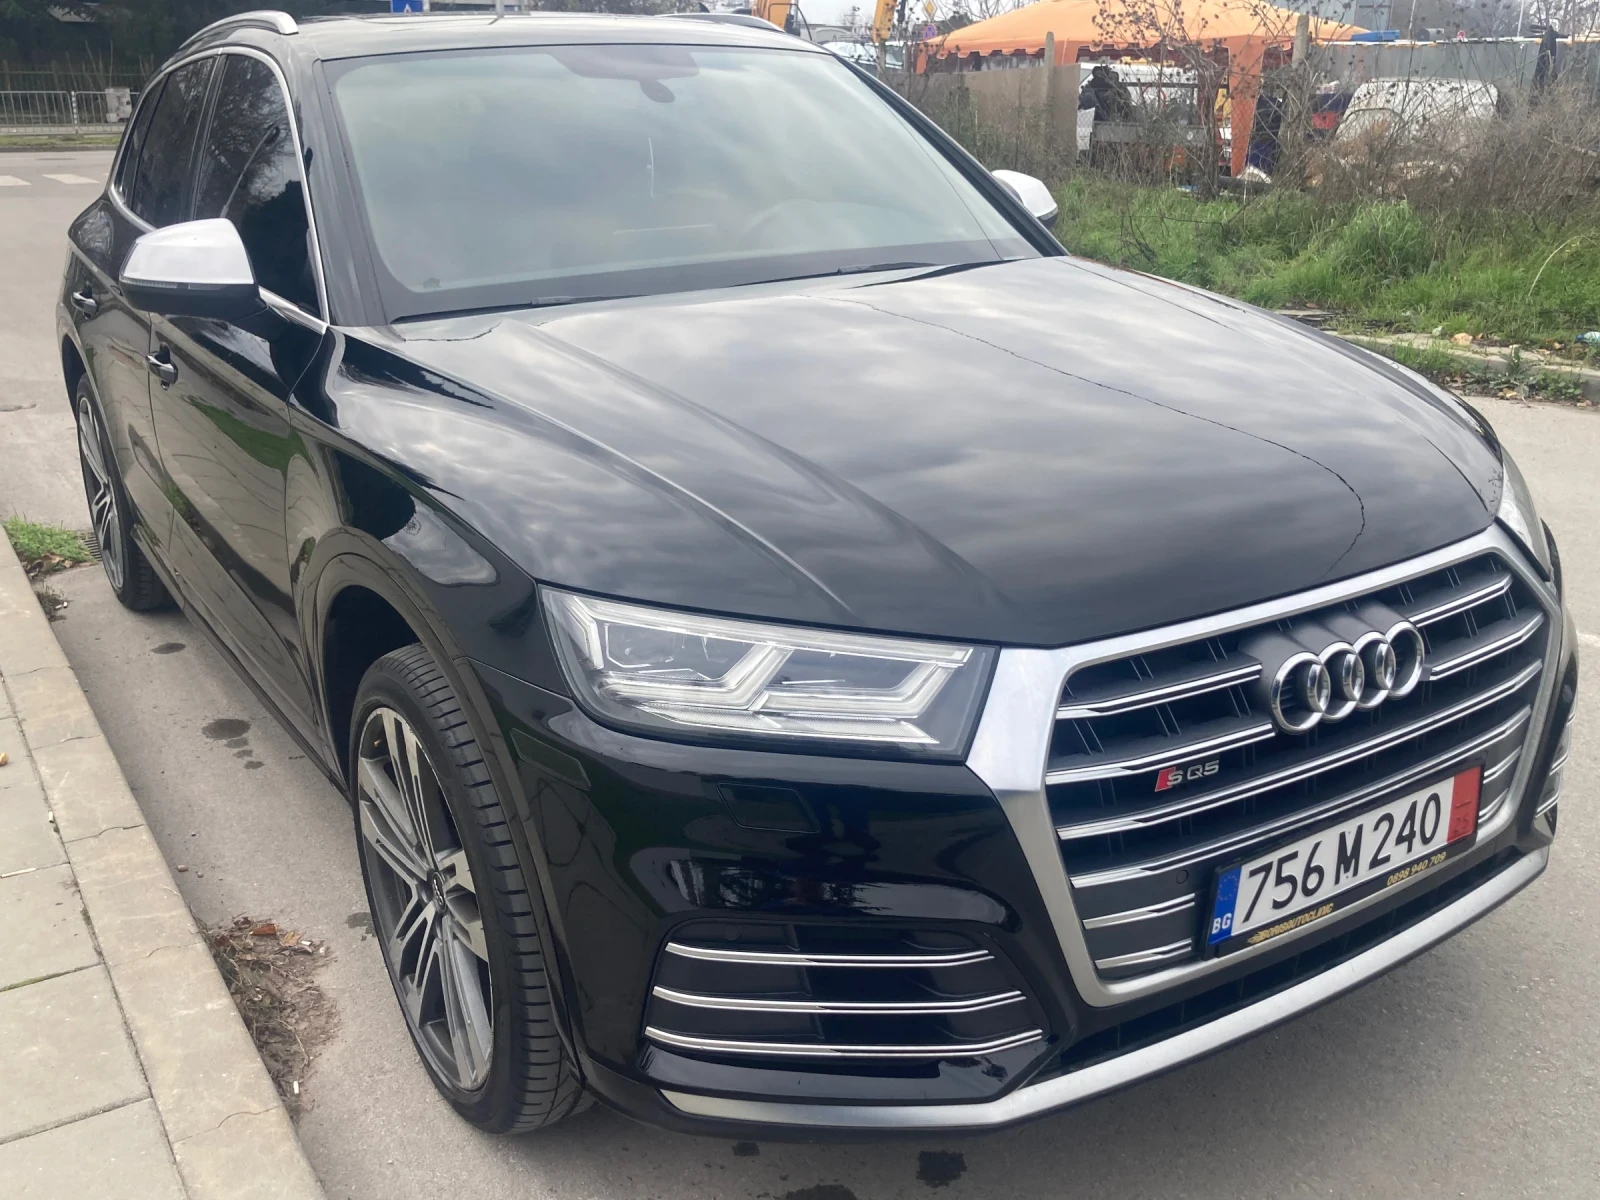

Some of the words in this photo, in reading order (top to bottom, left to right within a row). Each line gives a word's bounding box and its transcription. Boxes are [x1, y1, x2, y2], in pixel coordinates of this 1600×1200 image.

[1241, 840, 1324, 924] 756
[1334, 823, 1364, 886] M
[1369, 792, 1441, 871] 240
[1386, 867, 1411, 886] 0898
[1411, 859, 1429, 876] 940
[1429, 851, 1447, 868] 709
[1211, 912, 1232, 935] BG
